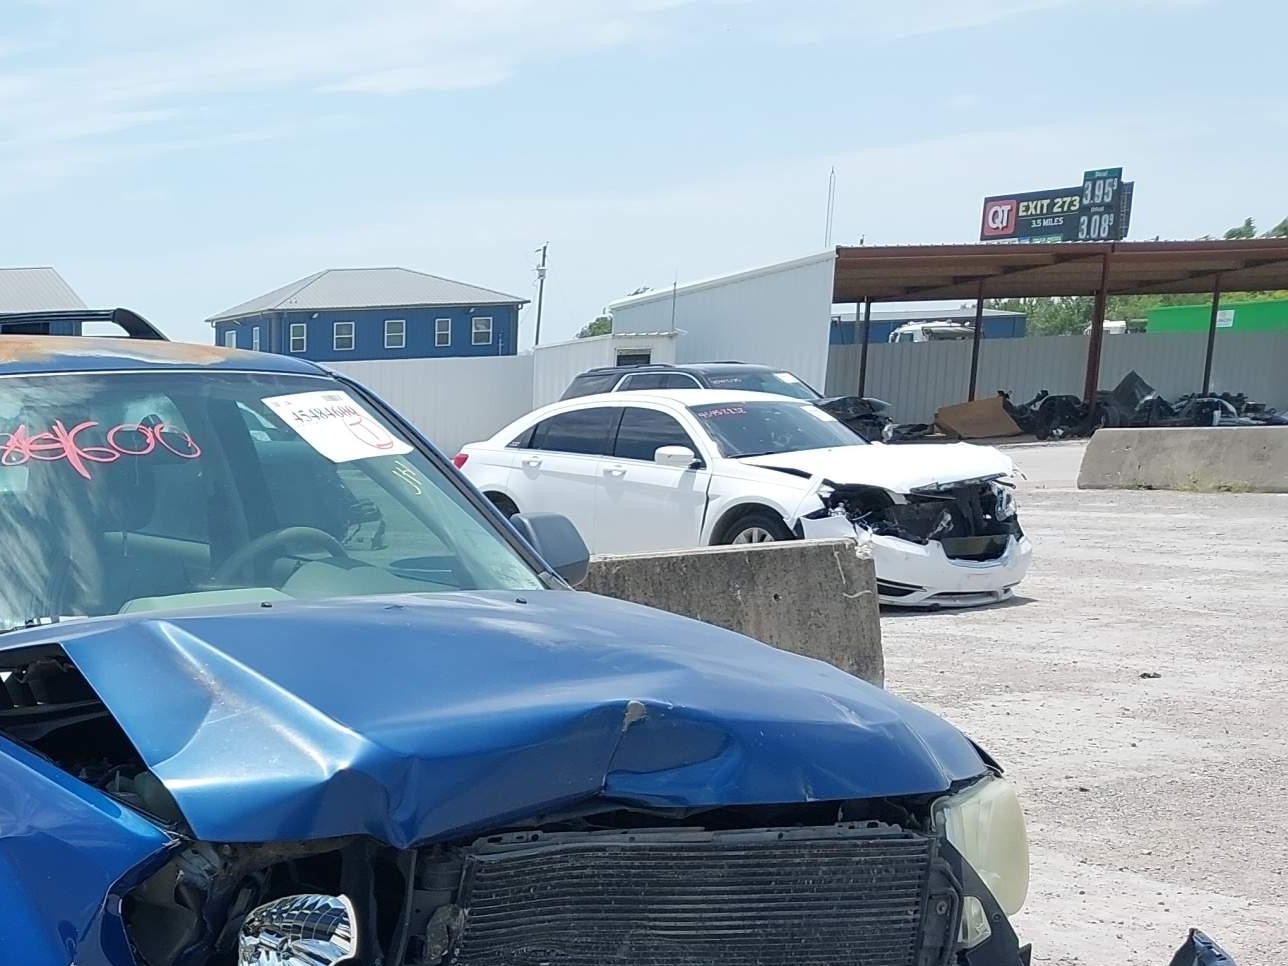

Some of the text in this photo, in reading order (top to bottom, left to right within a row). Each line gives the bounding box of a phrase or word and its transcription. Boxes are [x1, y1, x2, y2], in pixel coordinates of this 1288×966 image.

[1018, 195, 1080, 217] EXIT 273
[988, 205, 1011, 230] QT
[1043, 217, 1064, 226] MILES
